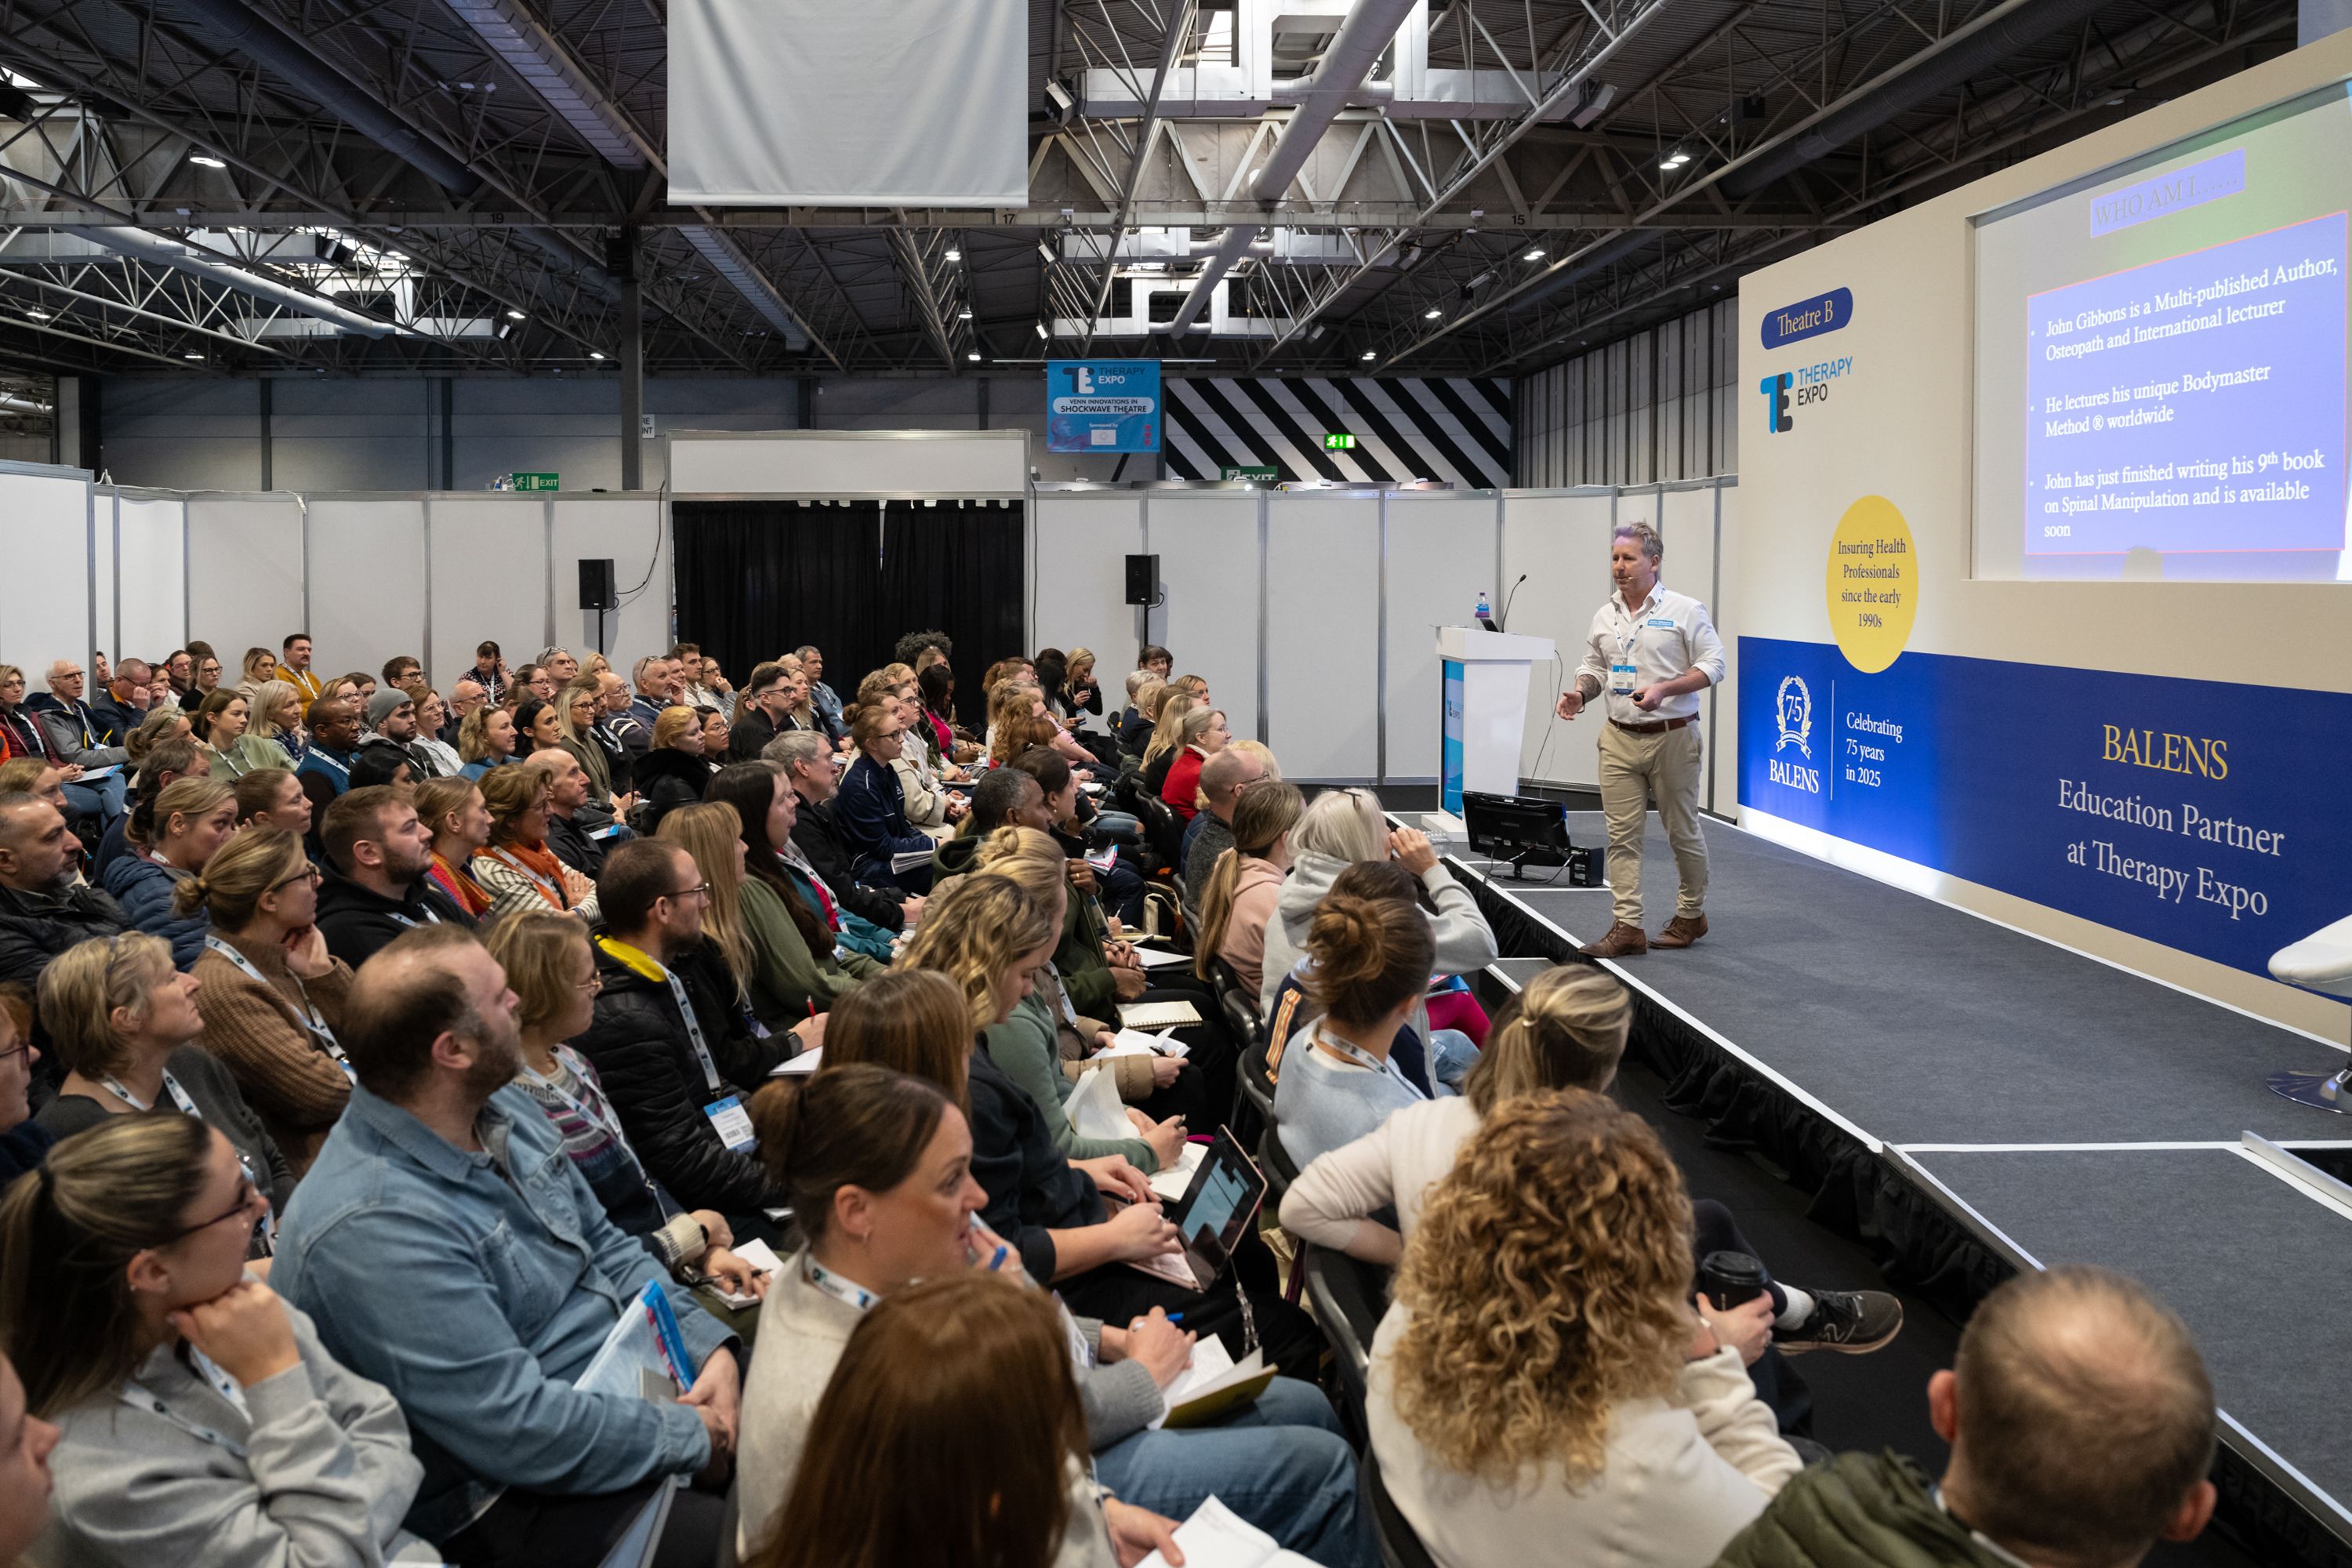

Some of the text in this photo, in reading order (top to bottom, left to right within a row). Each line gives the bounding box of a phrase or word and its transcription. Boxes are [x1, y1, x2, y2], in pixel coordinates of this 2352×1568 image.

[2095, 194, 2143, 227] WHO
[2148, 179, 2183, 212] AM
[490, 213, 504, 224] 19
[1003, 213, 1015, 224] 17
[1512, 215, 1526, 225] 15
[2045, 258, 2337, 337] John Gibbons is a Multi-published Author,
[1777, 299, 1833, 337] Theatre B
[2045, 299, 2286, 361] Osteopath and International lecturer
[1099, 376, 1126, 384] EXPO
[1798, 356, 1853, 386] THERAPY
[1798, 383, 1828, 405] EXPO
[2045, 365, 2271, 413] He lectures his unique Bodymaster
[2045, 416, 2089, 437] Method
[2107, 405, 2174, 429] worldwide
[2044, 448, 2325, 489] John has just finished writing his 9th book
[2044, 480, 2310, 516] on Spinal Manipulation and is available
[2044, 525, 2071, 538] soon
[1838, 538, 1906, 558] Insuring Health
[1844, 564, 1900, 579] Professionals
[1841, 588, 1901, 608] since the early
[1859, 613, 1882, 627] 1990s
[1786, 695, 1803, 722] 75
[1846, 711, 1903, 743] Celebrating
[1846, 739, 1885, 762] 75 years
[2103, 724, 2228, 781] BALENS
[1769, 758, 1819, 793] BALENS
[1846, 764, 1880, 787] in 2025
[2058, 778, 2285, 856] Education Partner
[2067, 839, 2268, 921] at Therapy Expo
